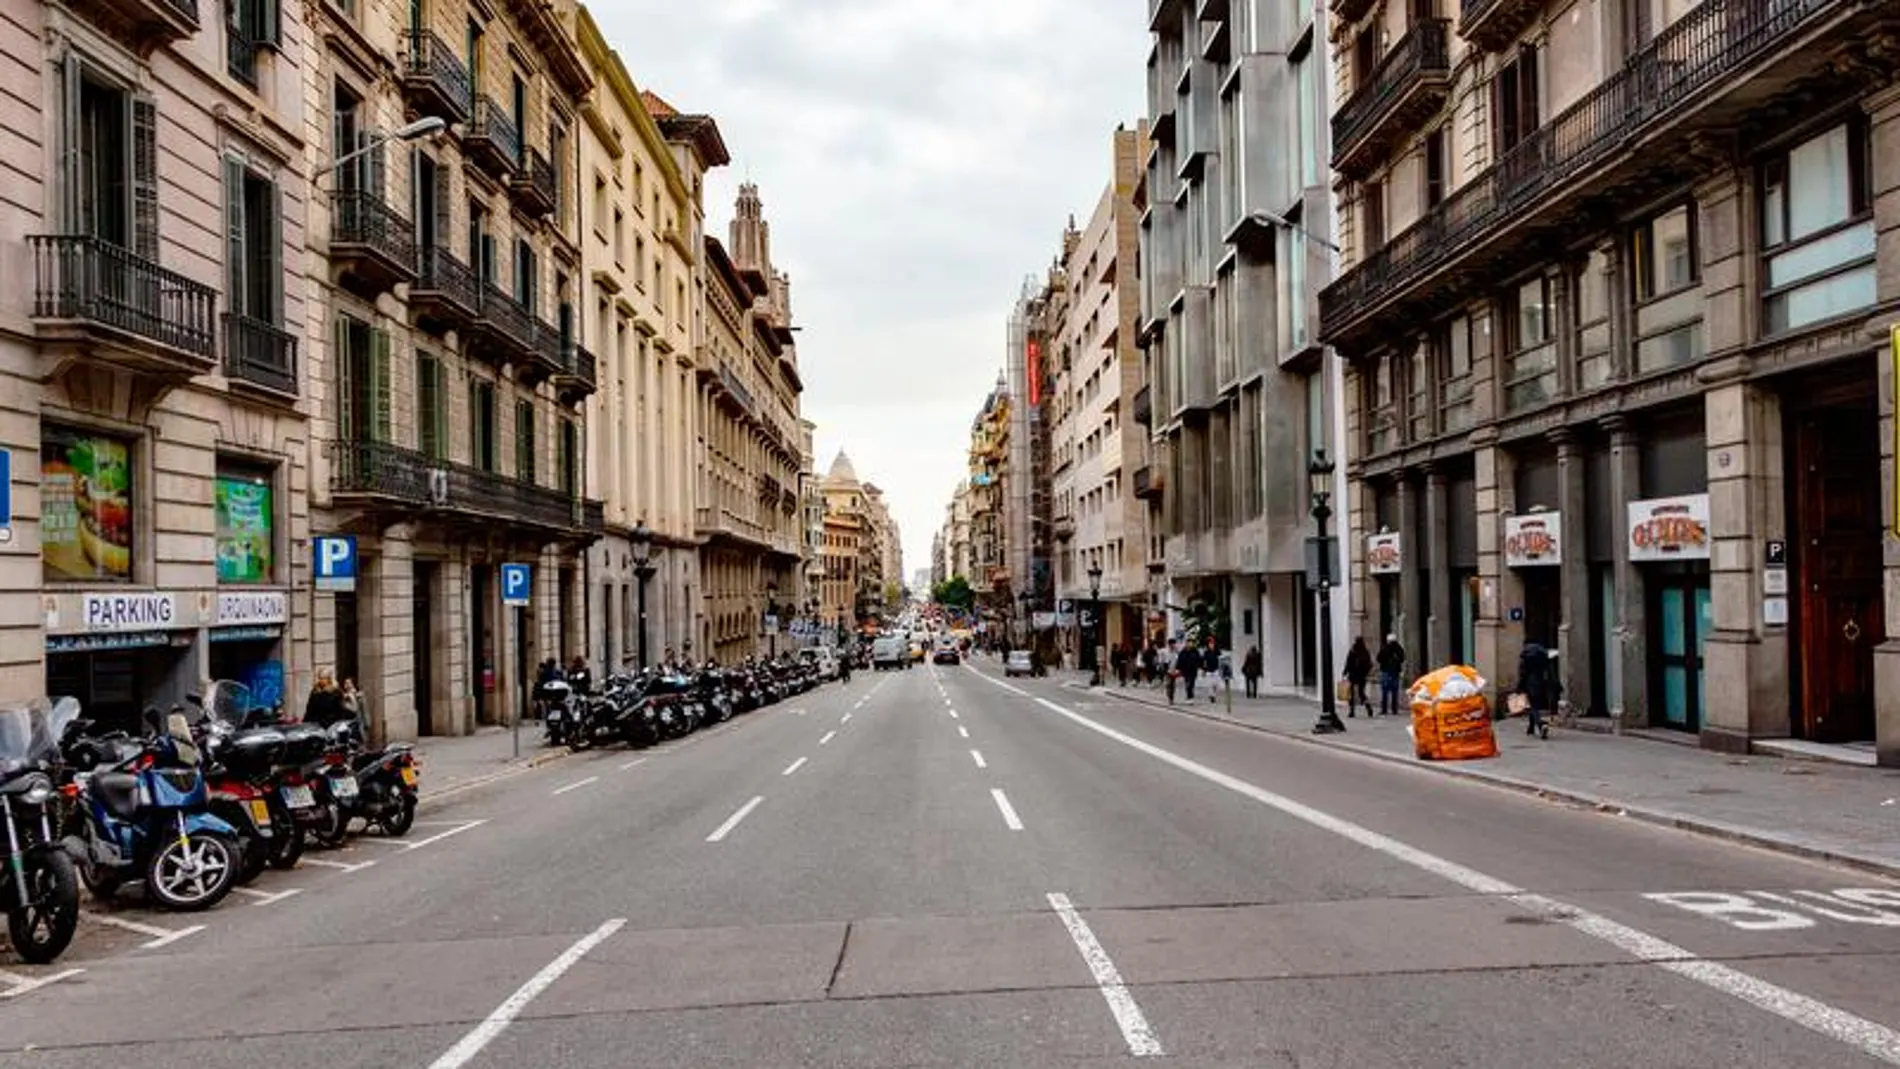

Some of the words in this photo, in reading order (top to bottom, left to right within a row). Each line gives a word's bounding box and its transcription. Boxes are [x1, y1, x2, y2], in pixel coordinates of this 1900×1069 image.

[321, 538, 350, 576] P
[1769, 543, 1781, 557] P
[507, 569, 524, 595] P
[88, 597, 172, 623] PARKING
